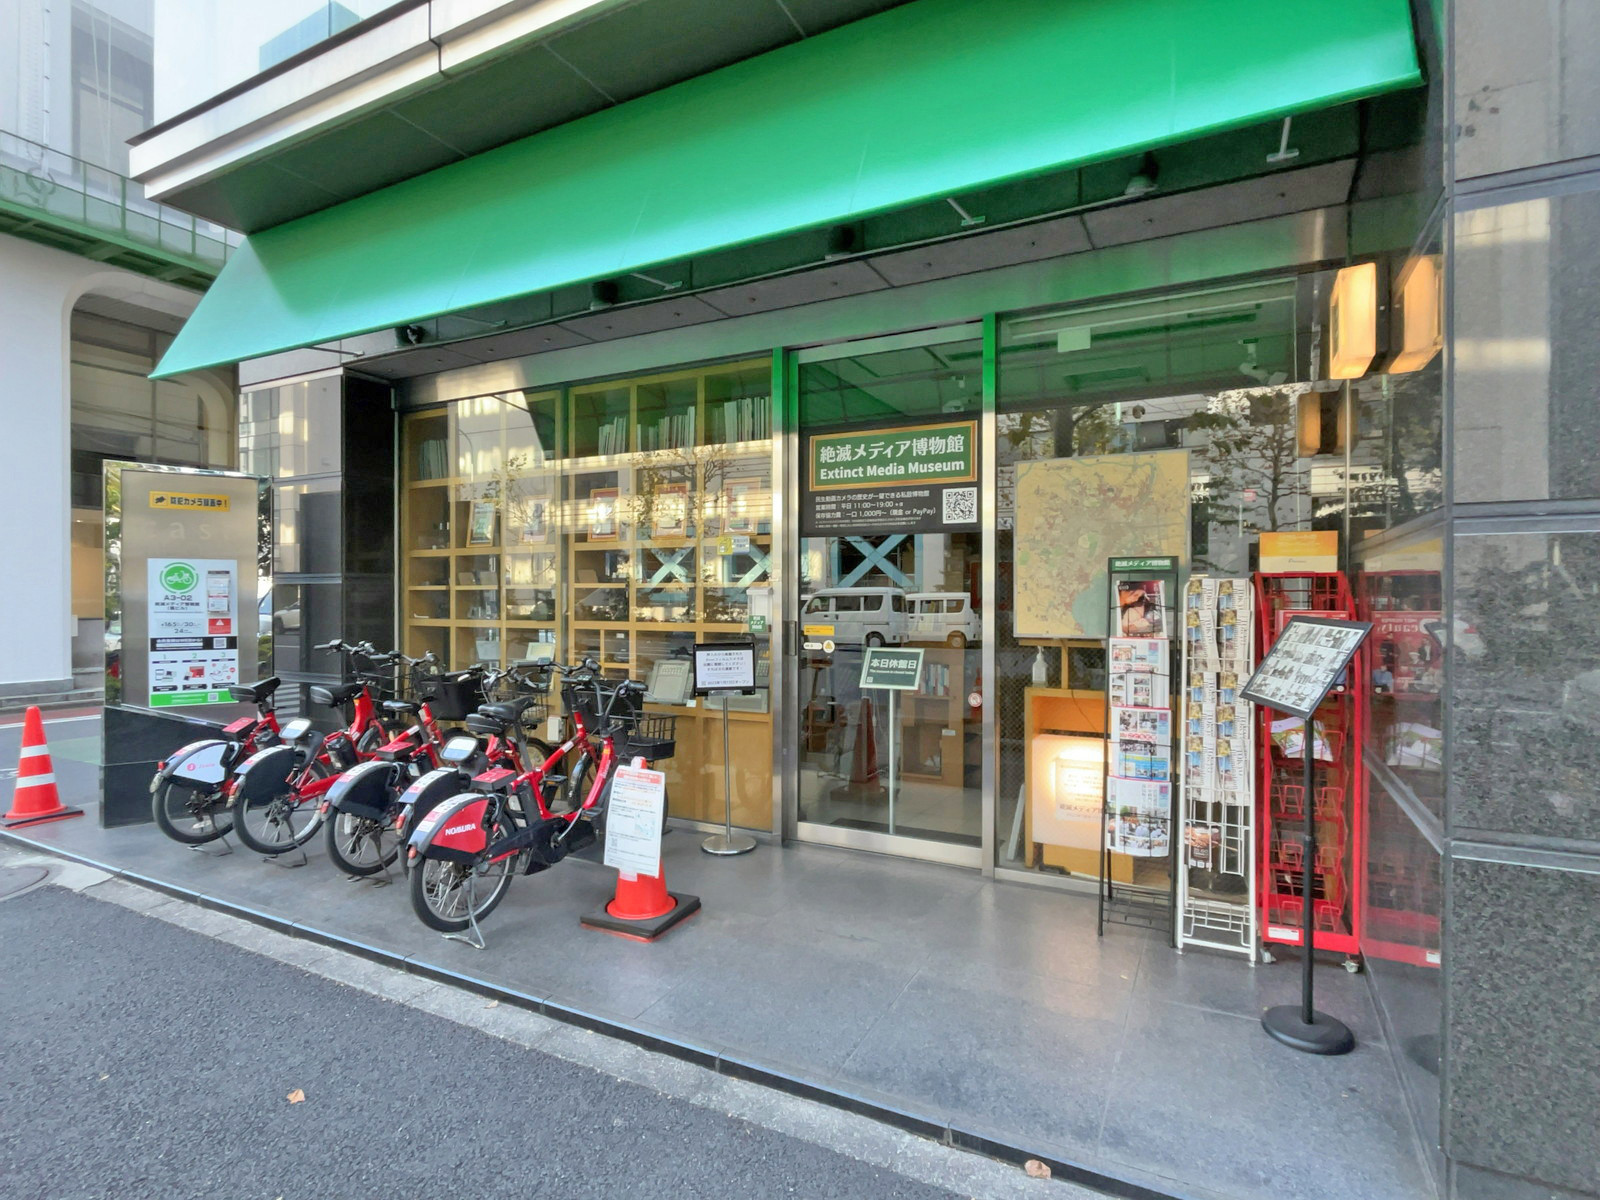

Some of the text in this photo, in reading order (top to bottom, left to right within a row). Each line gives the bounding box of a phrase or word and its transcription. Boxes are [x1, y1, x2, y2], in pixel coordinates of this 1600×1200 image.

[820, 434, 964, 463] 絶滅メディア博物館
[820, 460, 965, 480] Extinct Media Museum
[871, 658, 918, 669] 本日休館日
[445, 823, 476, 836] NOMURA
